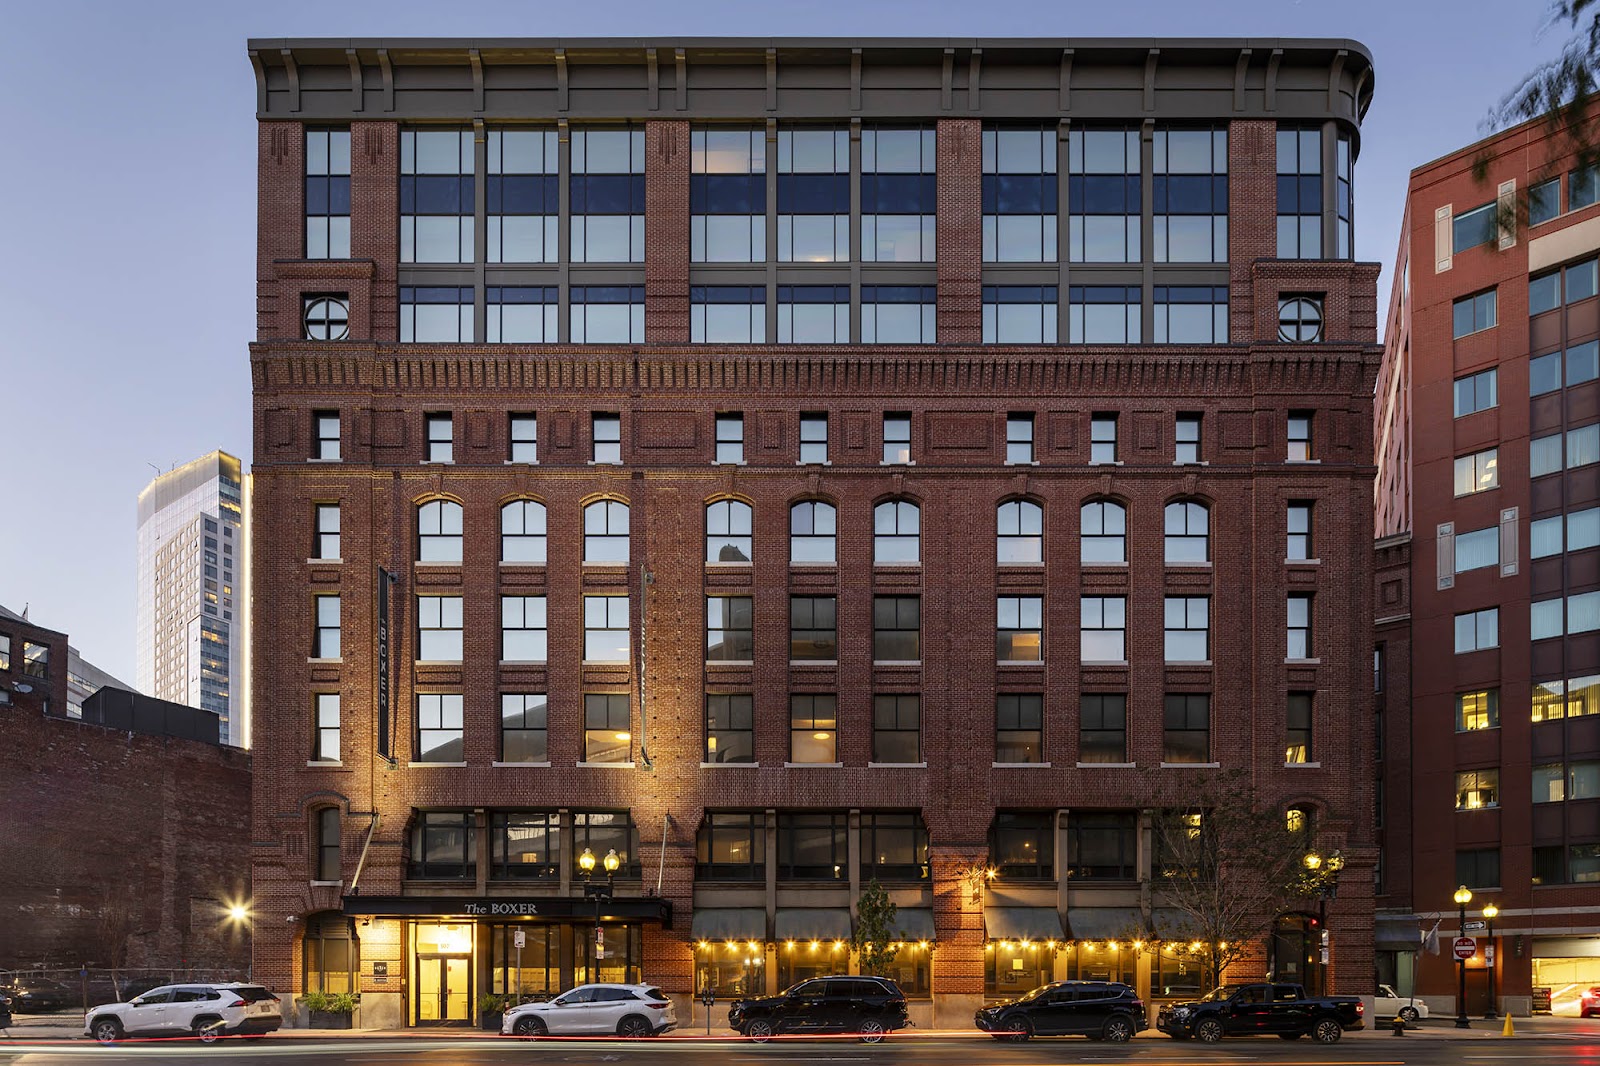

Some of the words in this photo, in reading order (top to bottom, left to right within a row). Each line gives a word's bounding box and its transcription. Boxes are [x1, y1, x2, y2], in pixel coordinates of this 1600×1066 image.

[380, 626, 388, 707] BOXER
[464, 903, 487, 914] The
[491, 903, 538, 914] BOXER
